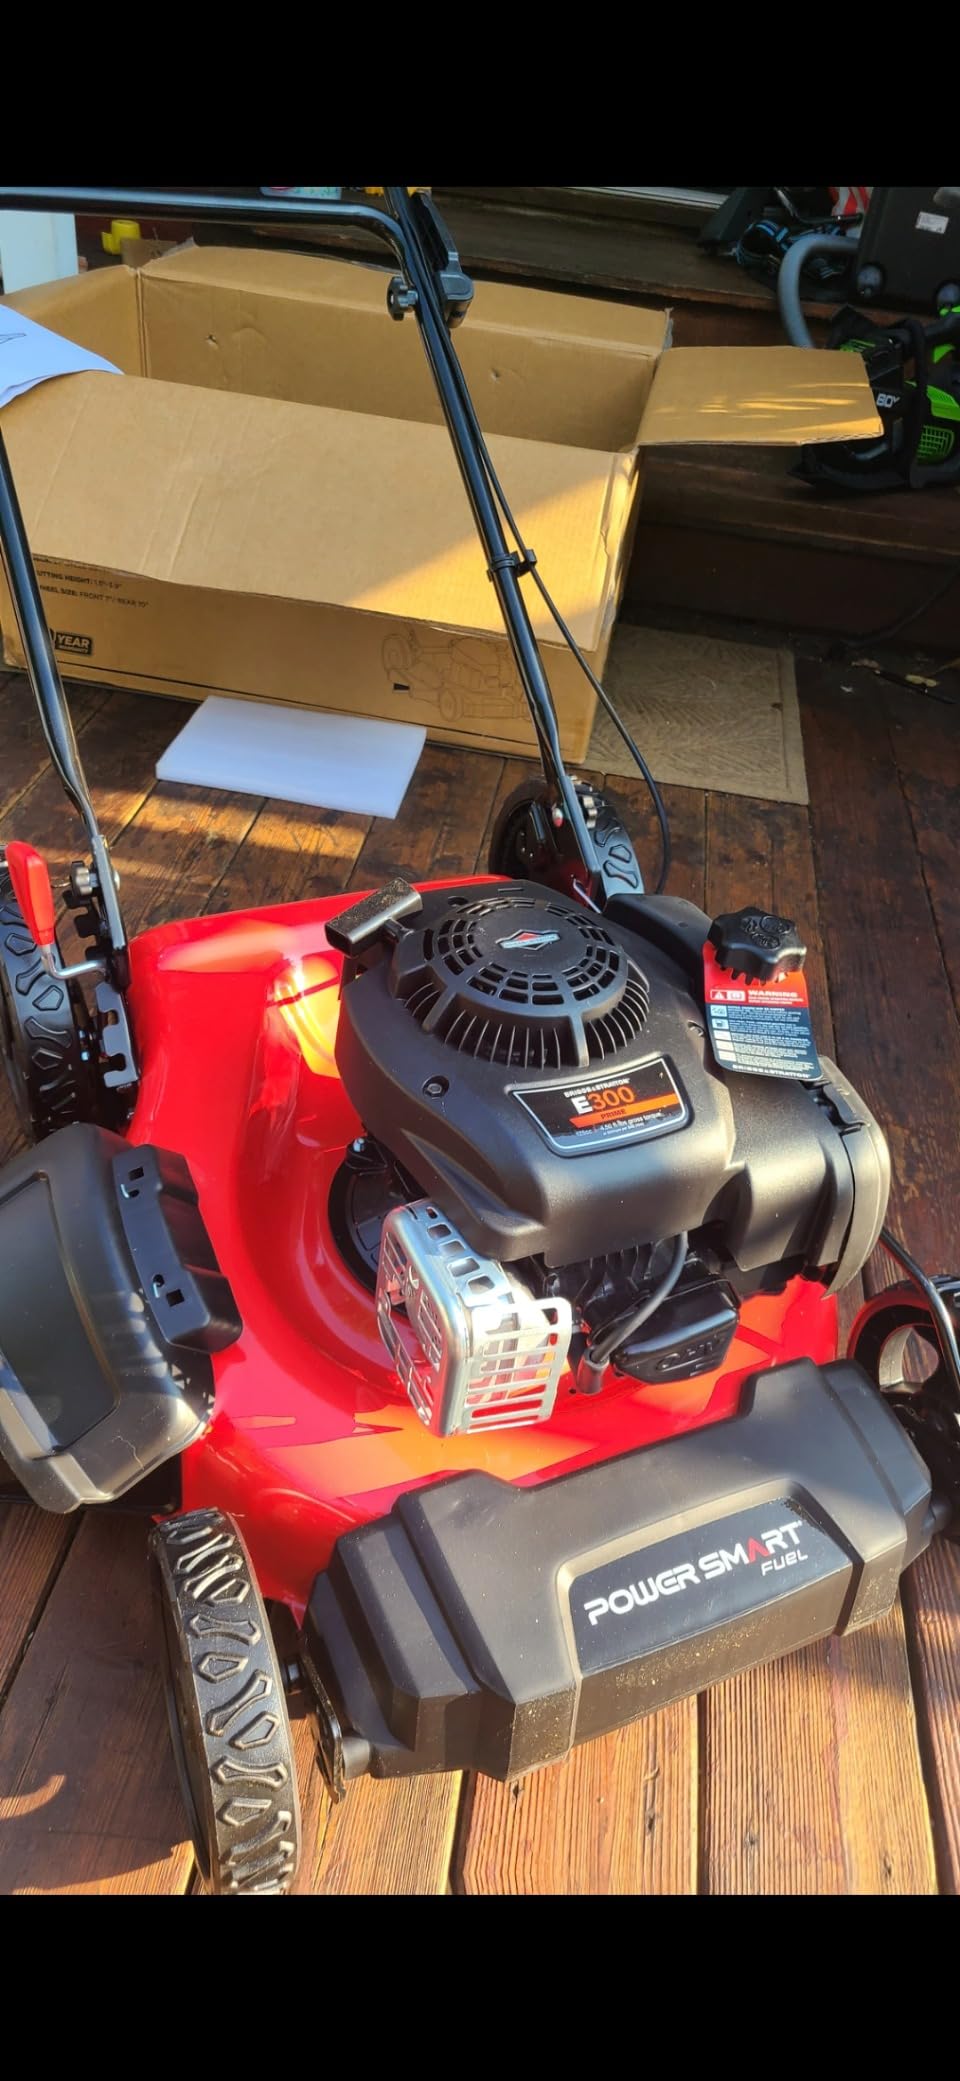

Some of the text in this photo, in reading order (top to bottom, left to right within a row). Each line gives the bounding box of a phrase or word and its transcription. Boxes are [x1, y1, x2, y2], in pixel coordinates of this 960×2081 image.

[79, 591, 104, 601] FRONT
[57, 633, 90, 649] YEAR
[748, 990, 798, 998] WARNING
[571, 1086, 635, 1115] E300
[600, 1108, 626, 1119] PRIME
[760, 1549, 808, 1576] FUEL
[583, 1521, 801, 1626] POWER SMART
